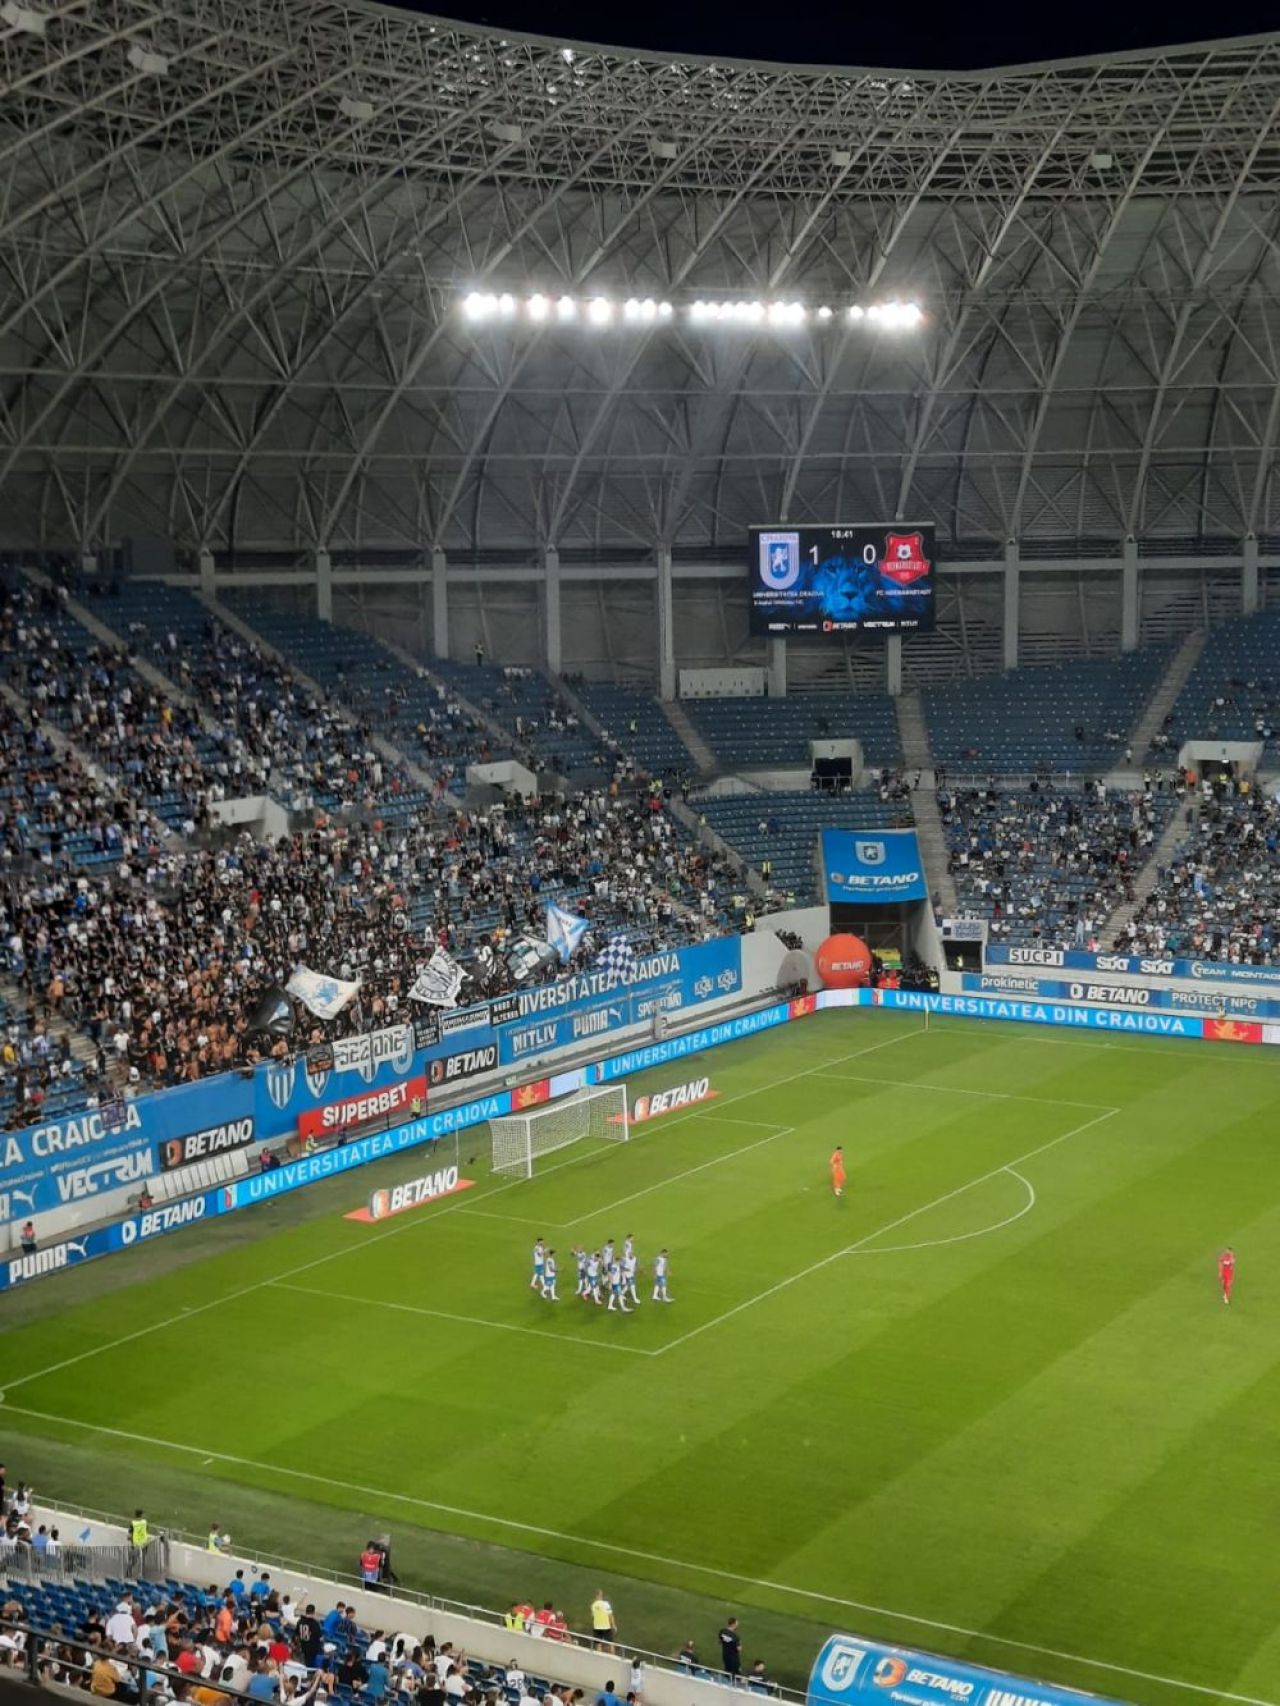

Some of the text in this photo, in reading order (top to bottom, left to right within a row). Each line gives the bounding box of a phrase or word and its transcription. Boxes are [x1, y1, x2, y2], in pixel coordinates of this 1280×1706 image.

[809, 544, 819, 566] 1
[863, 544, 876, 565] 0
[848, 872, 919, 885] BETANO
[831, 960, 865, 971] BETANO
[981, 975, 1039, 990] prokinetic
[895, 992, 1185, 1033] UNIVERSITATEA DIN CRAIOVA
[1087, 986, 1149, 1005] BETANO
[1171, 992, 1228, 1007] PROTECT
[1231, 997, 1257, 1010] NPG
[512, 1023, 558, 1051] NITLIV
[573, 1009, 609, 1038] PUMA
[612, 1009, 781, 1074] UNIVERSITATEA DIN CRAIOVA
[446, 1045, 496, 1078] BETANO
[322, 1082, 408, 1127] SUPERBET
[649, 1077, 709, 1116] BETANO
[32, 1104, 142, 1157] CRAIOA
[184, 1119, 254, 1159] BETANO
[249, 1099, 499, 1198] UNIVERSITATEA DIN CRAIOVA
[56, 1147, 153, 1202] VECTRUM
[390, 1165, 459, 1211] BETANO
[140, 1197, 206, 1237] BETANO
[9, 1244, 67, 1284] PUMA
[905, 1668, 974, 1696] BETANO
